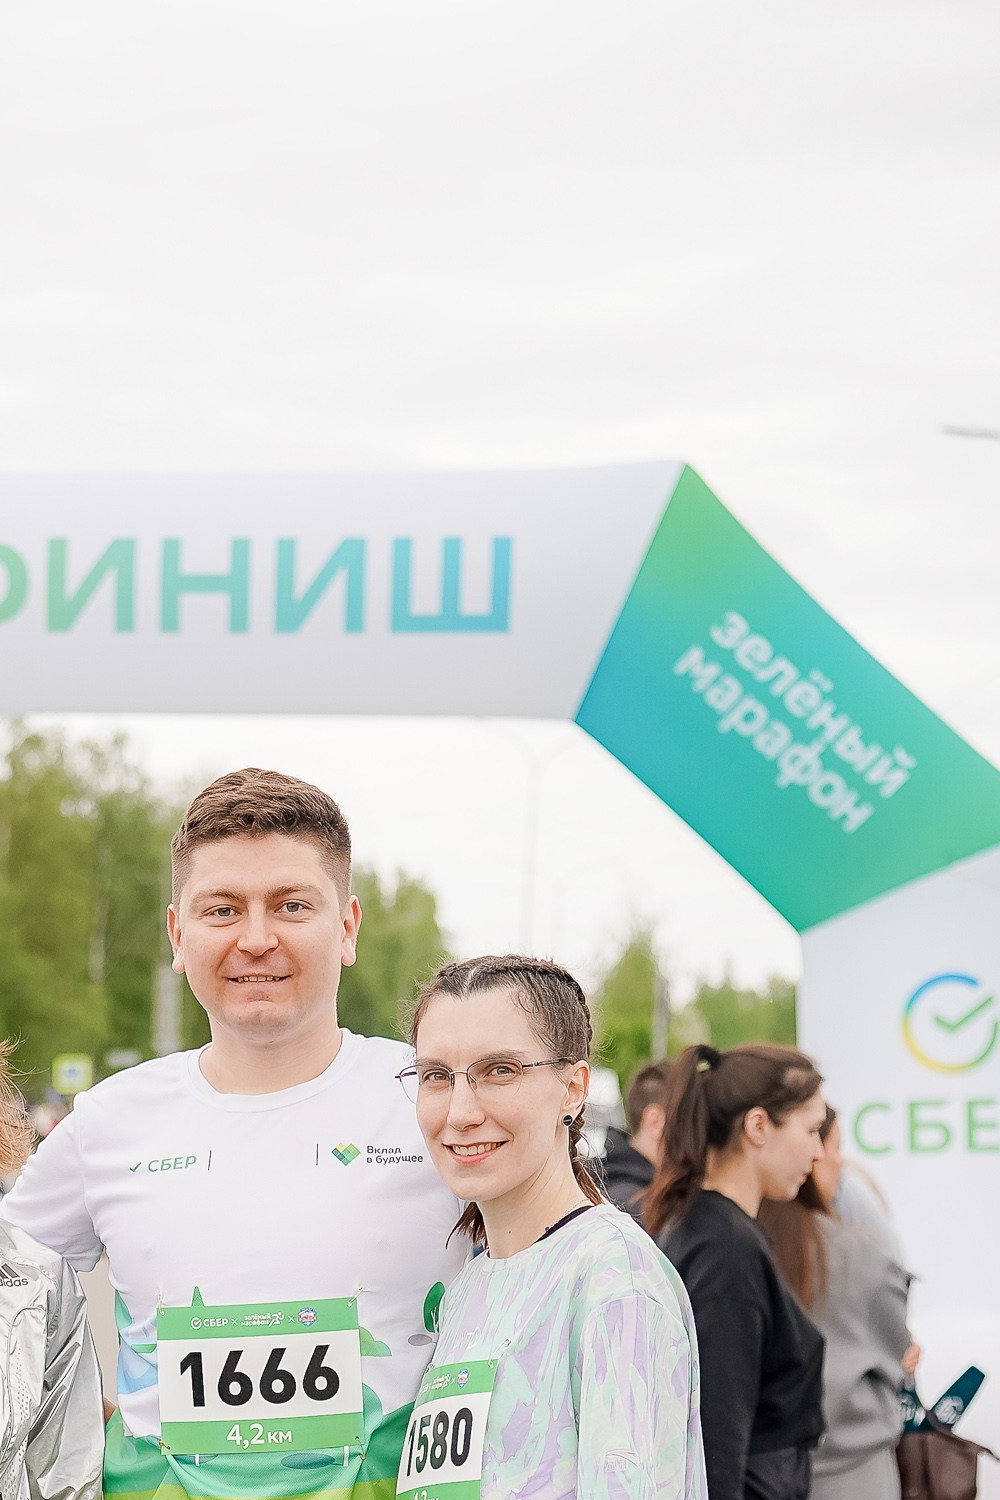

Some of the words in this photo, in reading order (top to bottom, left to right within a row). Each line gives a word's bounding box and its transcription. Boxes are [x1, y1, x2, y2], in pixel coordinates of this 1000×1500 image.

[709, 609, 918, 798] зелёный
[673, 643, 876, 834] марафон
[366, 1145, 402, 1155] Вклад
[375, 1155, 424, 1166] будущее
[147, 1155, 198, 1173] СБЕР
[203, 1318, 229, 1328] СБЕР
[180, 1344, 340, 1407] 1666
[226, 1423, 265, 1449] 4,2
[406, 1407, 474, 1477] 1580
